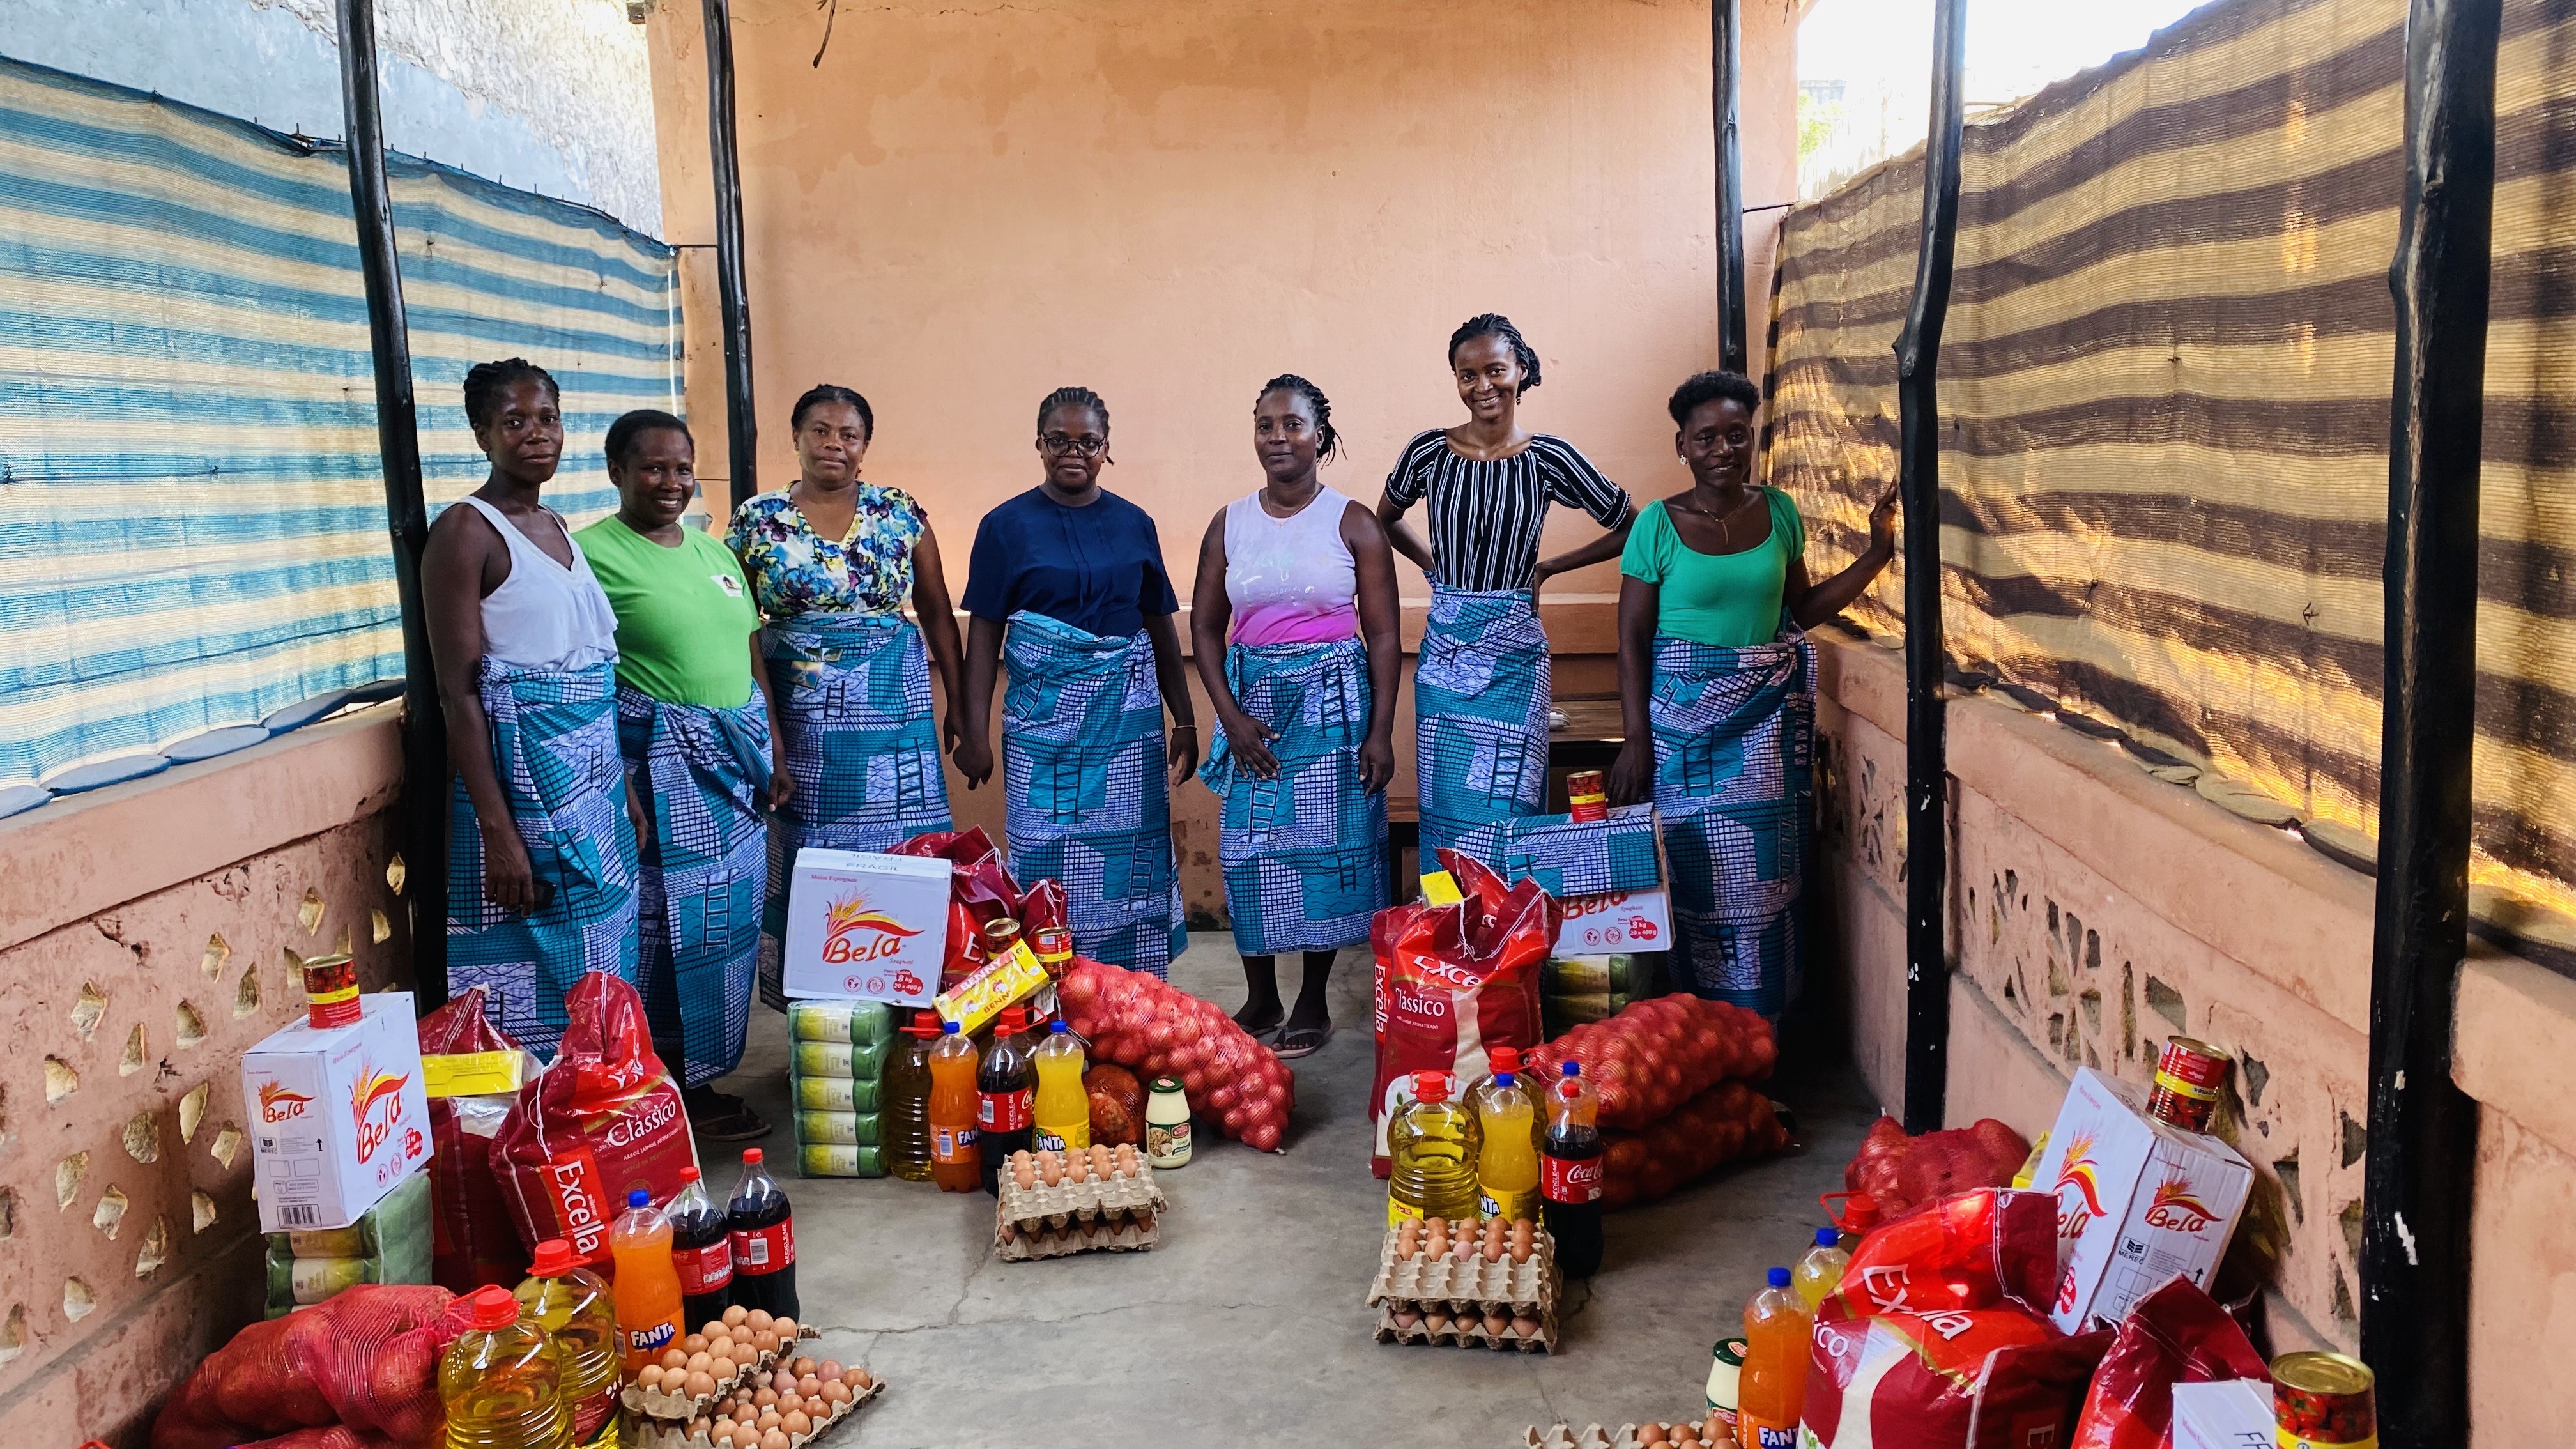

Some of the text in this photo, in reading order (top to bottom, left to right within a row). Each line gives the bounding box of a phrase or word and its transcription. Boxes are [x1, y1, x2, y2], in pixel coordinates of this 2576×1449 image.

[822, 934, 901, 963] Bela
[905, 976, 913, 984] kg
[960, 959, 1002, 991] BENNY
[1413, 955, 1483, 987] Exce
[984, 991, 1011, 1013] BENN
[1375, 963, 1390, 1033] Excella
[1395, 987, 1445, 1016] lássico
[263, 1101, 305, 1123] Bela
[357, 1091, 402, 1165] Bela
[957, 1126, 983, 1144] FAN
[554, 1160, 606, 1255] Excella
[1480, 1195, 1500, 1214] NTA
[2058, 1199, 2092, 1240] ela
[2145, 1208, 2206, 1232] Bela
[2118, 1250, 2144, 1265] MEREC
[1862, 1264, 1974, 1341] Exlla
[630, 1322, 676, 1347] FANTA
[1758, 1426, 1799, 1446] FANT
